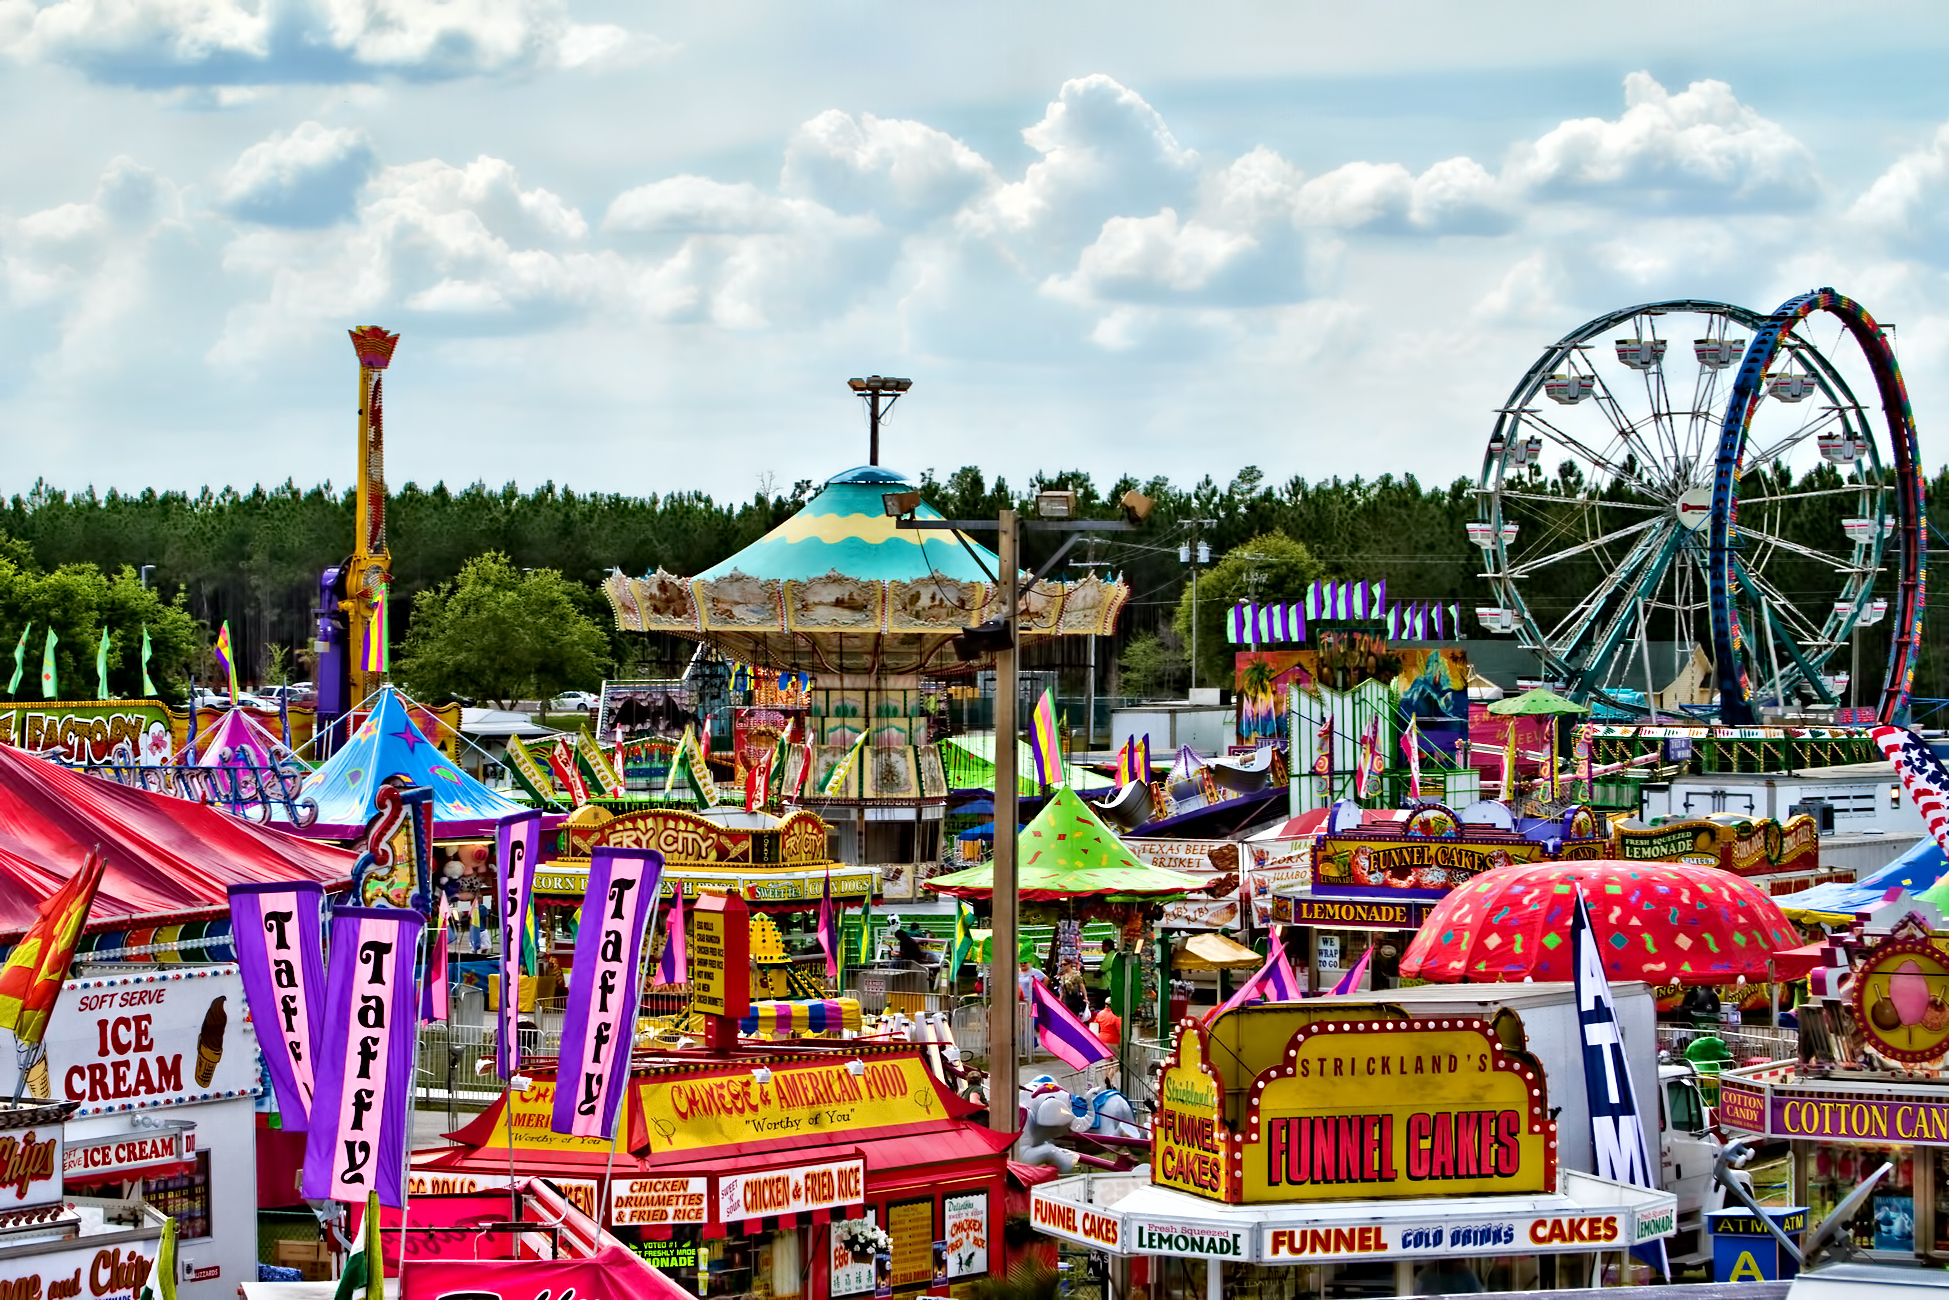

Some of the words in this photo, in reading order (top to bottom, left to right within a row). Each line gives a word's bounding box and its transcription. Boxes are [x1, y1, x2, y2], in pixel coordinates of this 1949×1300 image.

[26, 712, 147, 765] FACTORY
[608, 828, 655, 849] FRY
[659, 829, 717, 859] CITY
[785, 833, 802, 857] FRY
[803, 832, 823, 853] CITY
[1625, 838, 1650, 846] FRESH
[1652, 831, 1692, 845] SQUEEZED
[1140, 843, 1182, 855] TEXAS
[1185, 844, 1215, 855] BEEF
[1625, 839, 1694, 859] LEMONADE
[1151, 856, 1205, 868] BRISKET
[1369, 847, 1433, 872] FUNNEL
[1436, 847, 1495, 873] CAKES
[533, 875, 576, 890] CORN
[809, 881, 838, 895] CON
[841, 878, 870, 893] DOGS
[1271, 870, 1308, 883] JUMBO
[1320, 874, 1355, 884] LEMONADE
[755, 886, 785, 898] SWEET
[788, 886, 803, 898] TEA
[1164, 902, 1189, 925] RIBS
[1185, 903, 1210, 925] RIBS
[1301, 902, 1407, 924] LEMONADE
[1321, 936, 1335, 947] WE
[1318, 949, 1339, 959] WRAP
[1318, 959, 1327, 968] TO
[1328, 960, 1338, 969] GO
[78, 992, 119, 1012] SOFT
[119, 988, 166, 1008] SERVE
[264, 910, 313, 1101] Taff
[577, 877, 636, 1116] Taffy
[97, 1013, 154, 1057] ICE
[340, 940, 393, 1185] Taffy
[1300, 1053, 1488, 1078] STRICKLAND'S
[1580, 928, 1648, 1188] ATM
[64, 1054, 183, 1102] CREAM
[670, 1078, 759, 1121] CHINESE
[759, 1083, 772, 1106] &
[773, 1067, 864, 1110] AMERICAN
[864, 1063, 909, 1100] FOOD
[1165, 1076, 1215, 1111] Strickland's
[1722, 1091, 1764, 1110] COTTON
[504, 1112, 551, 1128] AMERI
[745, 1116, 801, 1132] "Worthy
[807, 1113, 823, 1126] of
[824, 1108, 855, 1124] You"
[1726, 1104, 1759, 1122] CANDY
[1783, 1100, 1889, 1138] COTTON
[1895, 1105, 1949, 1140] CAN
[561, 1136, 575, 1144] of
[1164, 1109, 1220, 1154] FUNNEL
[63, 1148, 78, 1161] OFT
[83, 1145, 112, 1169] ICE
[114, 1136, 175, 1164] CREAM
[1267, 1114, 1398, 1187] FUNNEL
[1406, 1110, 1521, 1181] CAKES
[63, 1157, 83, 1172] ERVE
[1162, 1145, 1221, 1193] CAKES
[628, 1178, 690, 1194] CHICKEN
[720, 1179, 739, 1200] SWEET
[743, 1174, 790, 1214] CHICKEN
[791, 1179, 803, 1202] &
[804, 1167, 836, 1207] FRIED
[836, 1164, 862, 1202] RICE
[614, 1193, 705, 1209] DRUMMETTES
[726, 1199, 741, 1218] SOUR
[948, 1200, 974, 1213] Delicious
[615, 1210, 627, 1224] &
[629, 1208, 669, 1223] FRIED
[672, 1207, 705, 1221] RICE
[1033, 1198, 1078, 1234] FUNNEL
[1081, 1212, 1118, 1246] CAKES
[1637, 1208, 1674, 1240] LEMONADE
[1640, 1211, 1652, 1220] Fresh
[1717, 1218, 1768, 1233] ATM
[1783, 1214, 1804, 1232] ATM
[950, 1218, 983, 1238] CHICKEN
[1148, 1223, 1178, 1234] Fresh
[1181, 1226, 1230, 1239] Squeezed
[1270, 1226, 1388, 1257] FUNNEL
[1401, 1225, 1445, 1250] COLD
[1449, 1222, 1515, 1248] DRINKS
[1528, 1215, 1618, 1246] CAKES
[643, 1241, 667, 1249] VOTED
[972, 1235, 986, 1250] RICE
[1138, 1225, 1242, 1257] LEMONADE
[644, 1249, 675, 1257] FRESHLY
[676, 1248, 696, 1256] MADE
[48, 1267, 82, 1300] and
[90, 1247, 155, 1300] Chip
[195, 1268, 218, 1279] LIZZARDS
